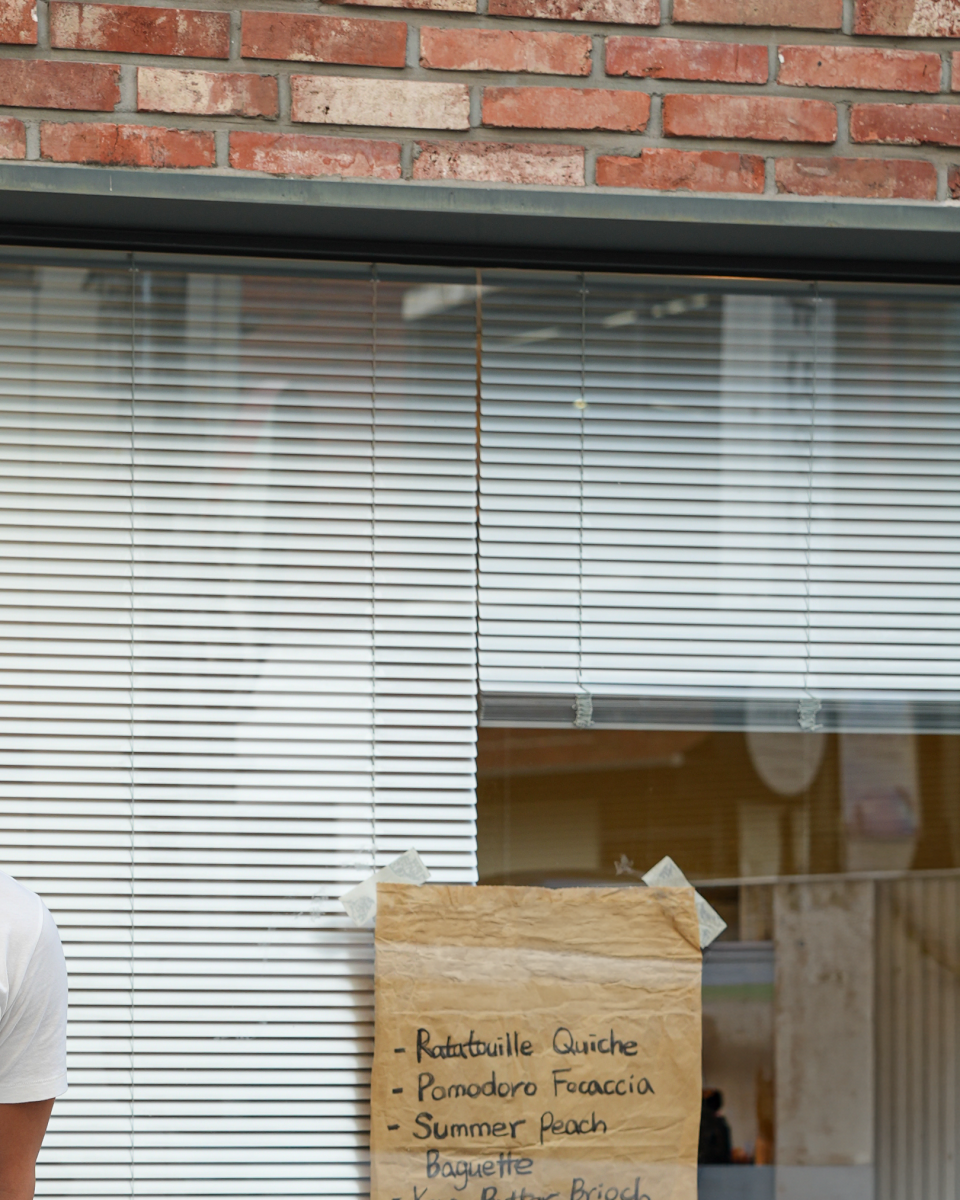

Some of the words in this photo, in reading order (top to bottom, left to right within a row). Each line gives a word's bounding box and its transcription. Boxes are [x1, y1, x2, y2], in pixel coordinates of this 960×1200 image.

[417, 1027, 533, 1063] Ratatouille
[552, 1026, 639, 1057] Quiche
[417, 1070, 538, 1102] Pomodoro
[412, 1111, 527, 1140] Summer
[539, 1110, 608, 1145] Peach
[425, 1148, 534, 1191] Baguette
